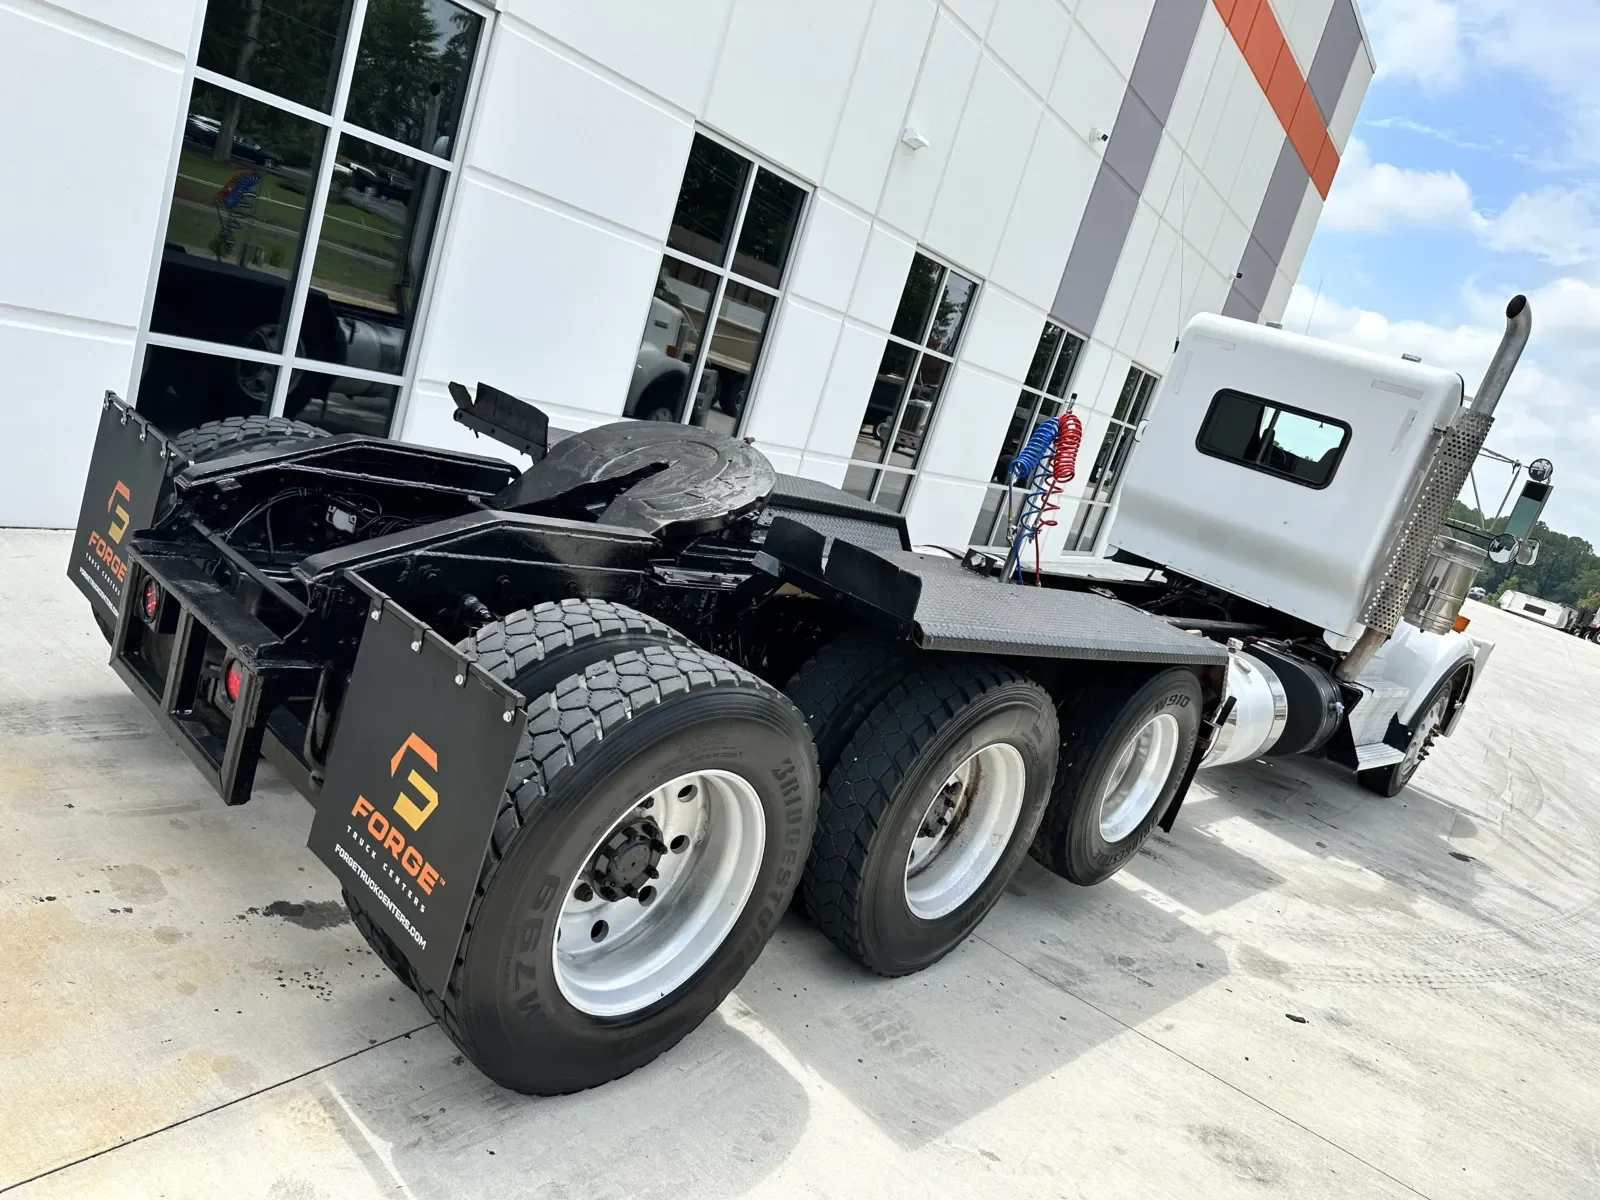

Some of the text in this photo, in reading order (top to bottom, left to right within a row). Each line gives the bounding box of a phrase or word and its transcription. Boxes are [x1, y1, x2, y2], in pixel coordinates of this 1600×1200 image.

[88, 530, 128, 584] FORGE
[346, 824, 426, 913] TRUCK CENTERS
[350, 794, 440, 896] FORGE
[334, 843, 427, 950] FORGETRUCKCENTERS.COM
